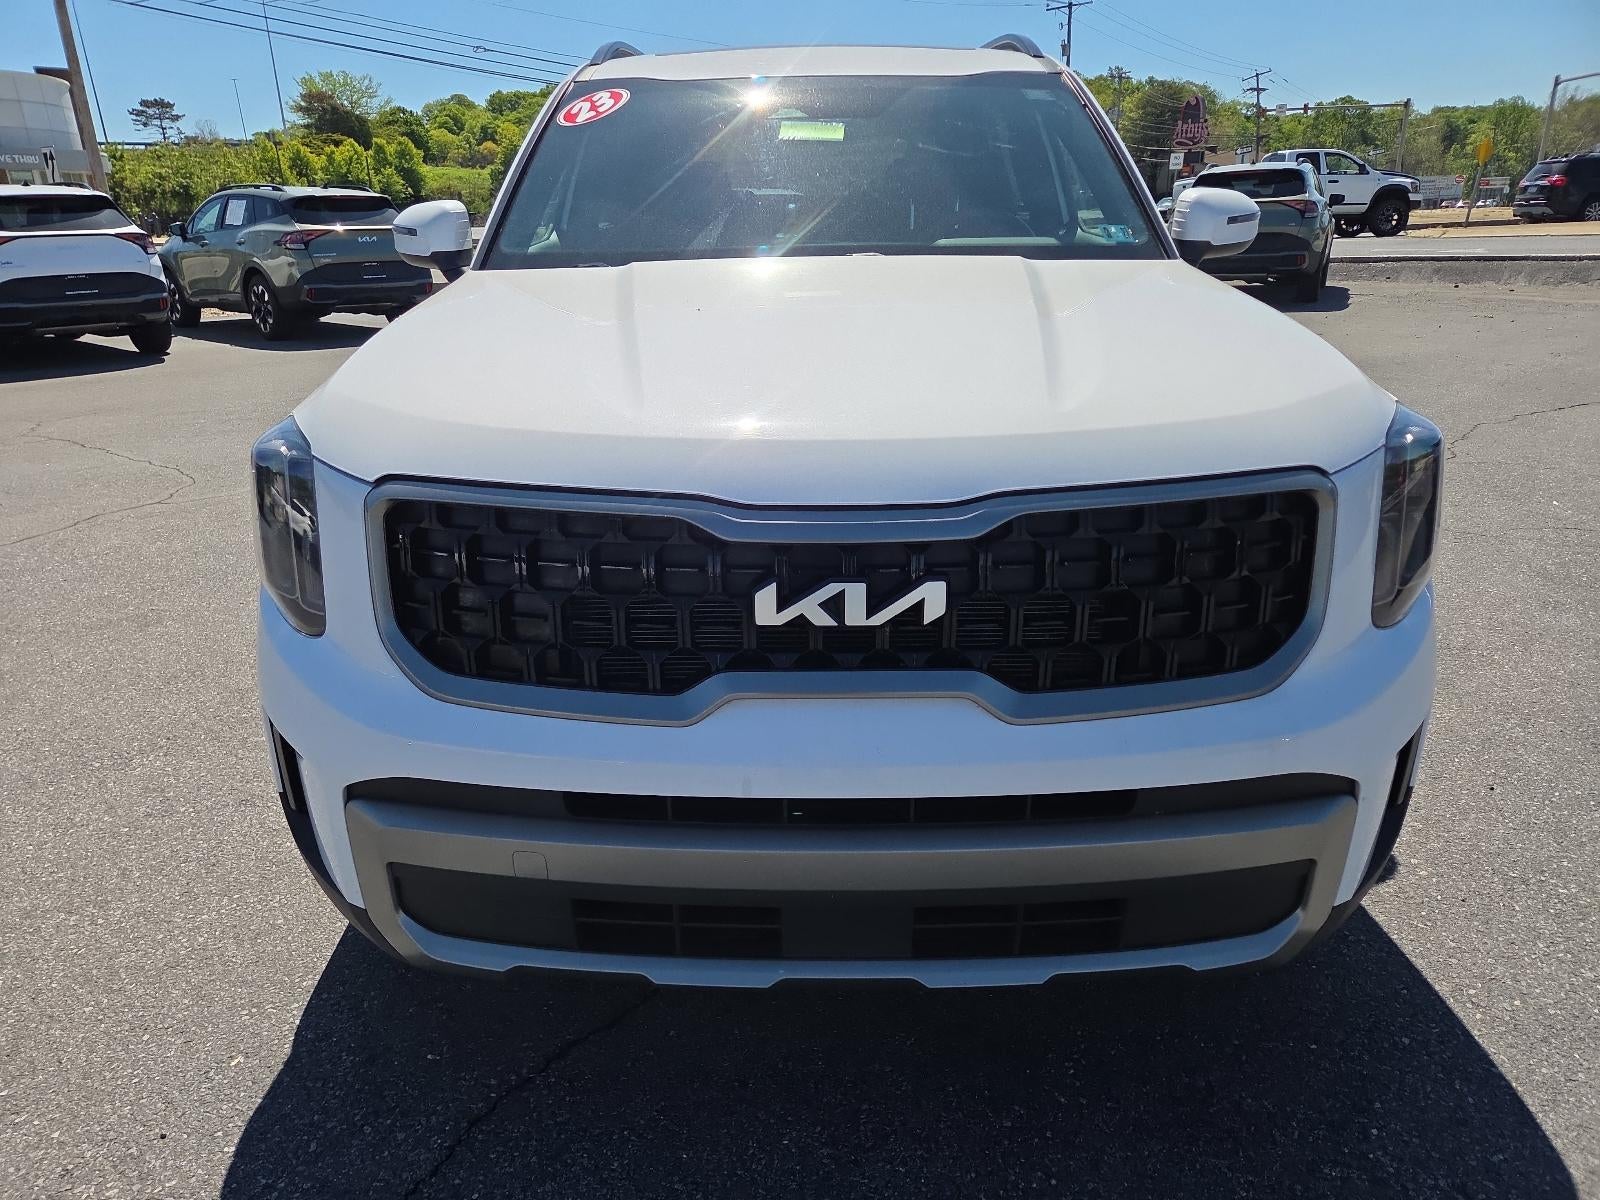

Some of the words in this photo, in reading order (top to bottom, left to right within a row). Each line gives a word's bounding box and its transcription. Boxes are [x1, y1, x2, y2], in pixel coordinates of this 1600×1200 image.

[570, 91, 615, 122] 23
[1173, 118, 1209, 142] Arby's
[13, 154, 39, 164] THRU
[755, 581, 946, 626] KIA
